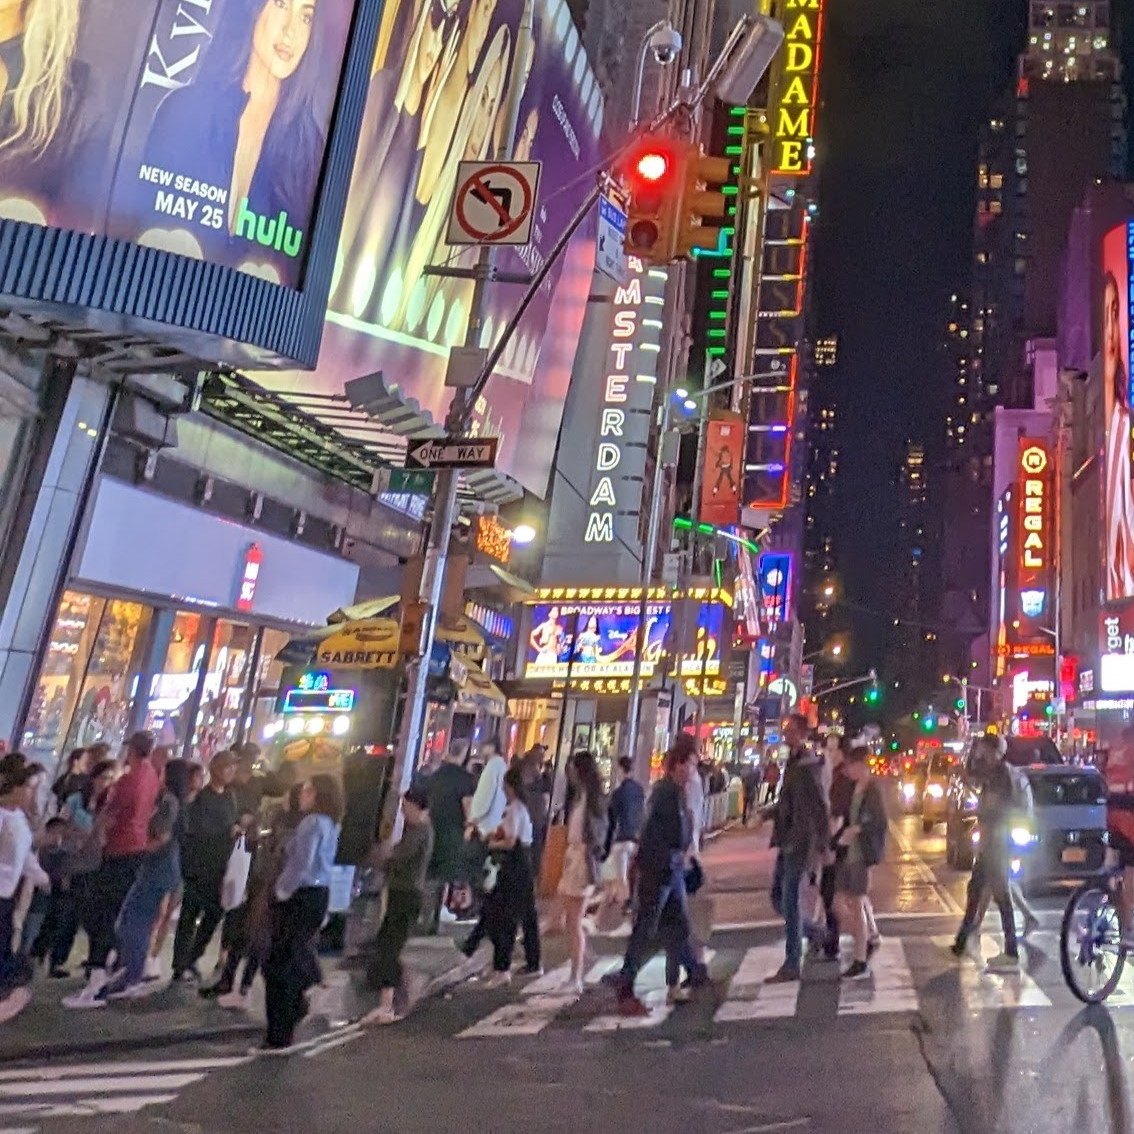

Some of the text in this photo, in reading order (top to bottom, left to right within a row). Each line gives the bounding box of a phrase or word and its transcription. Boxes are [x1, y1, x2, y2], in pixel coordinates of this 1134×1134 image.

[139, 165, 227, 204] NEW SEASON
[155, 191, 224, 229] MAY 25
[235, 197, 302, 257] hulu
[584, 255, 643, 542] AMSTERDAM
[420, 447, 484, 460] ONE WAY
[1023, 479, 1044, 568] REGAL
[561, 605, 664, 616] BROADWAY'S BIGEST
[321, 650, 396, 664] SABRETT
[1013, 645, 1055, 654] REGAL
